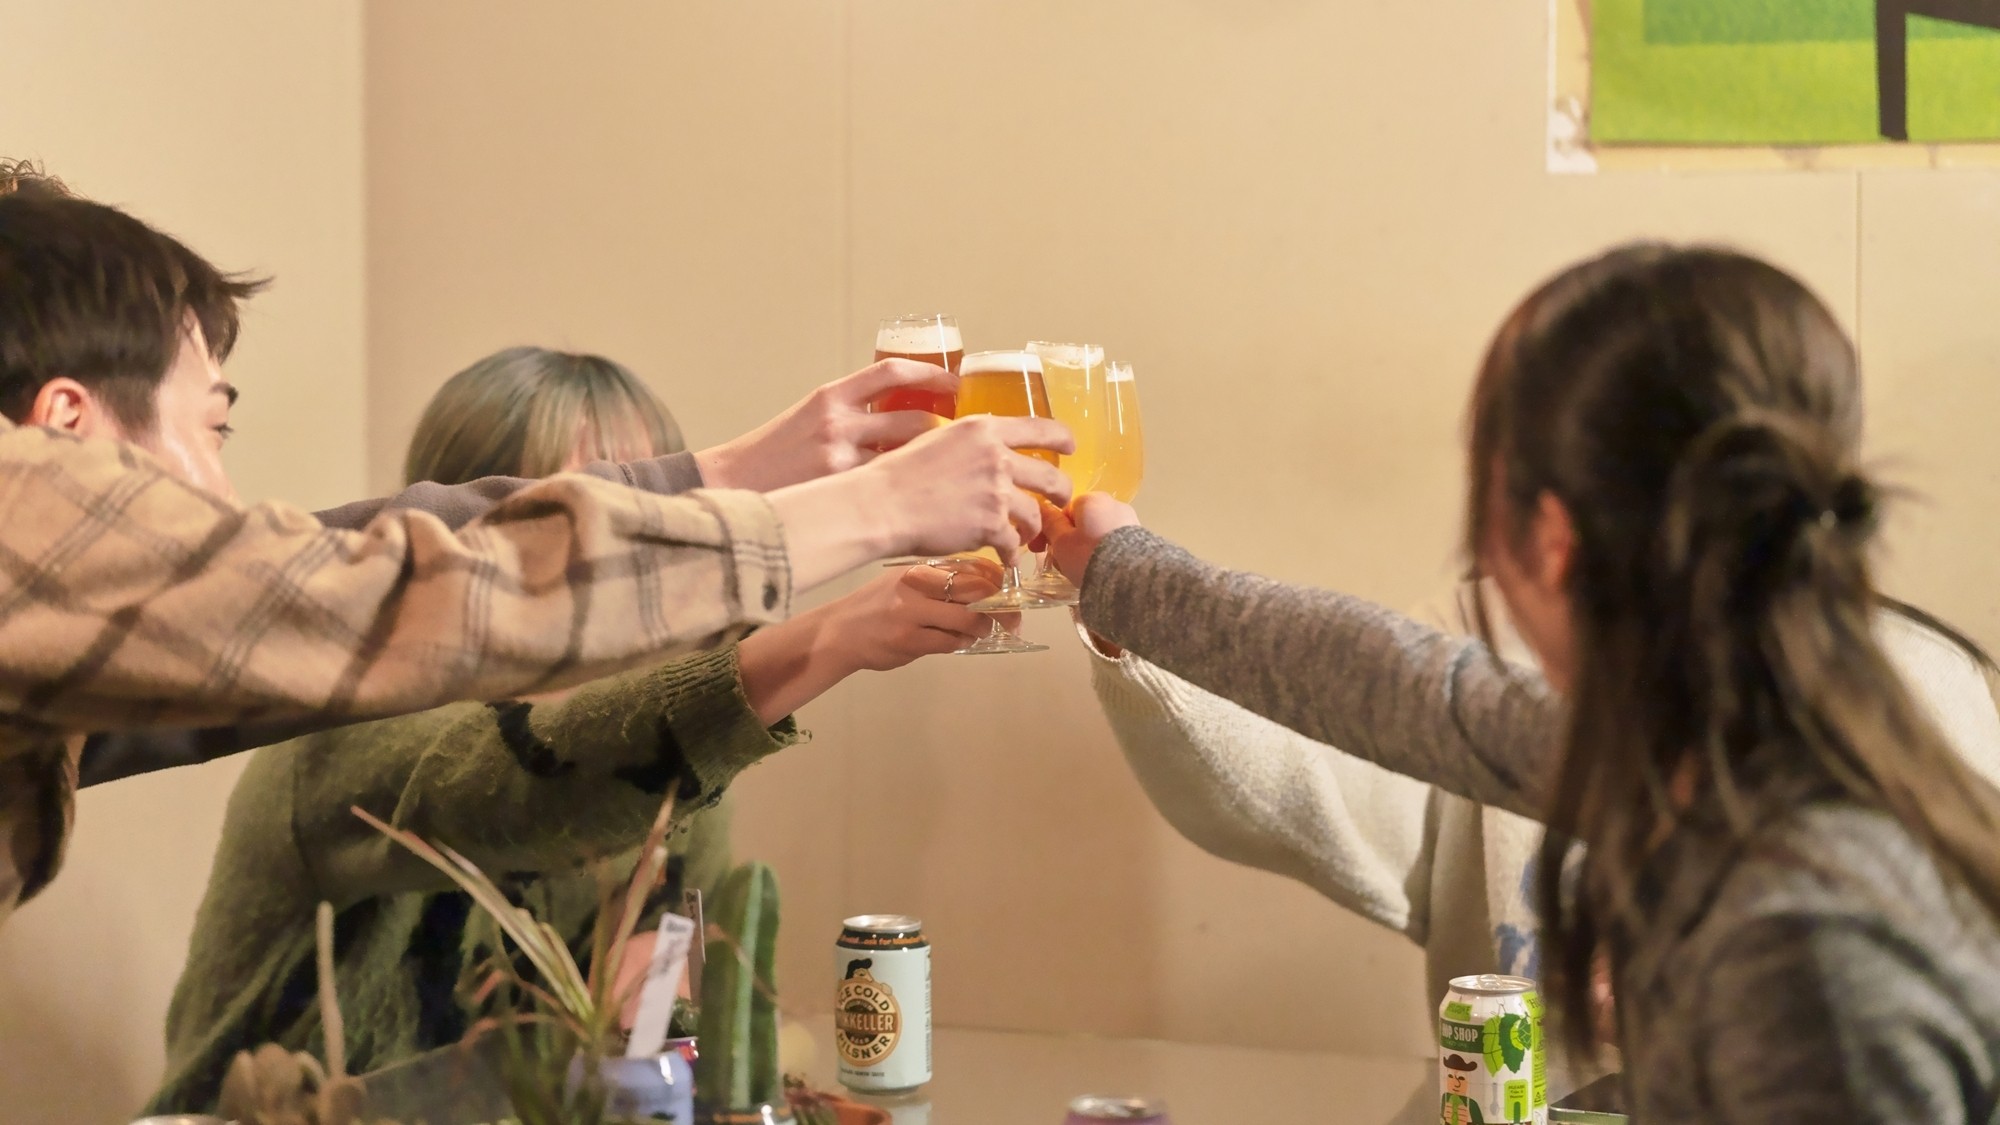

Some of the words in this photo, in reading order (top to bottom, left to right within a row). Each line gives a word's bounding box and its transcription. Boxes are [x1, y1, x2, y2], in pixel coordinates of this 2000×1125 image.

[853, 985, 890, 1011] COLD
[841, 1012, 894, 1031] KKELLER
[1453, 1026, 1479, 1042] SHOP
[839, 1032, 891, 1059] PILSNER
